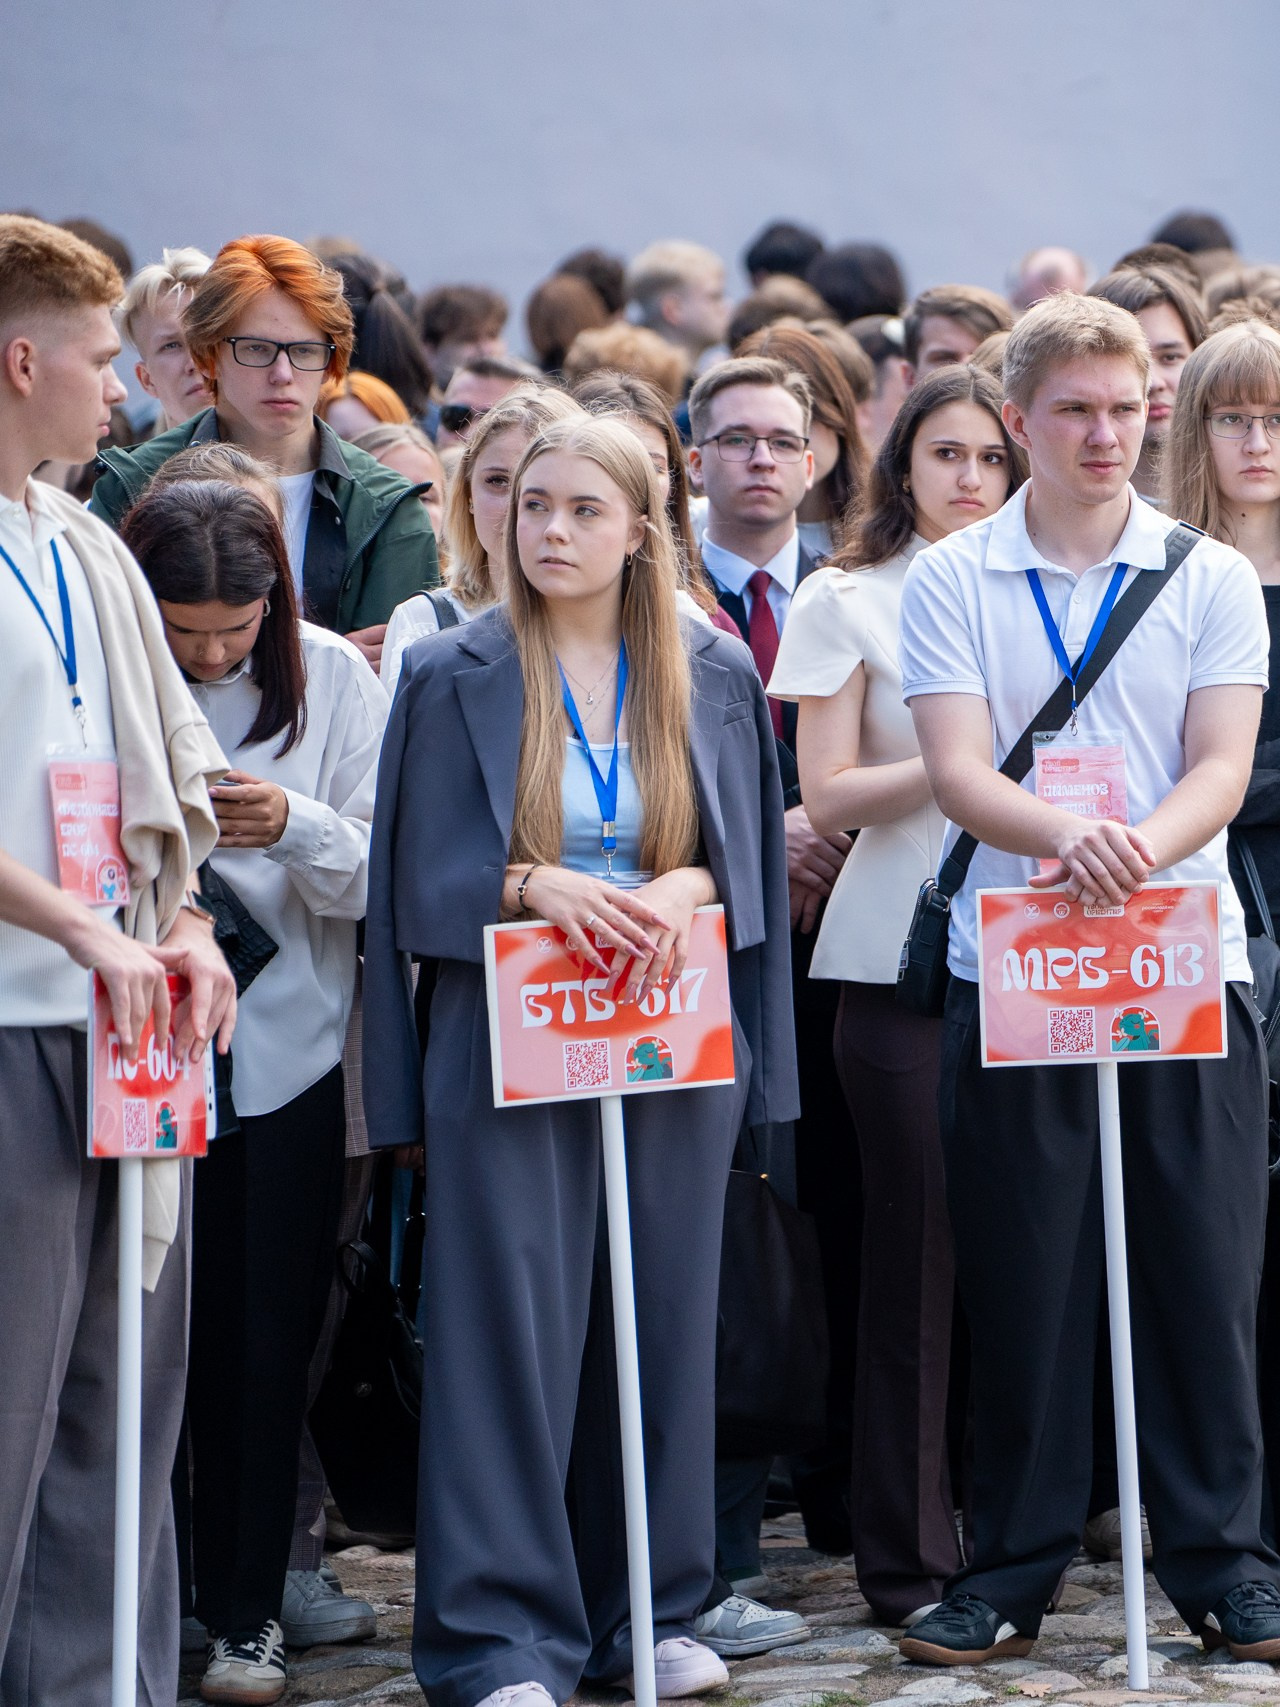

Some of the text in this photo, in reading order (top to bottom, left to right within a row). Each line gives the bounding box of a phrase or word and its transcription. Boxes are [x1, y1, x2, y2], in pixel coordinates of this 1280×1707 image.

[1043, 783, 1109, 797] ПИМЕНОВ
[1001, 942, 1205, 992] МРБ-613
[519, 967, 709, 1029] БТБ-617
